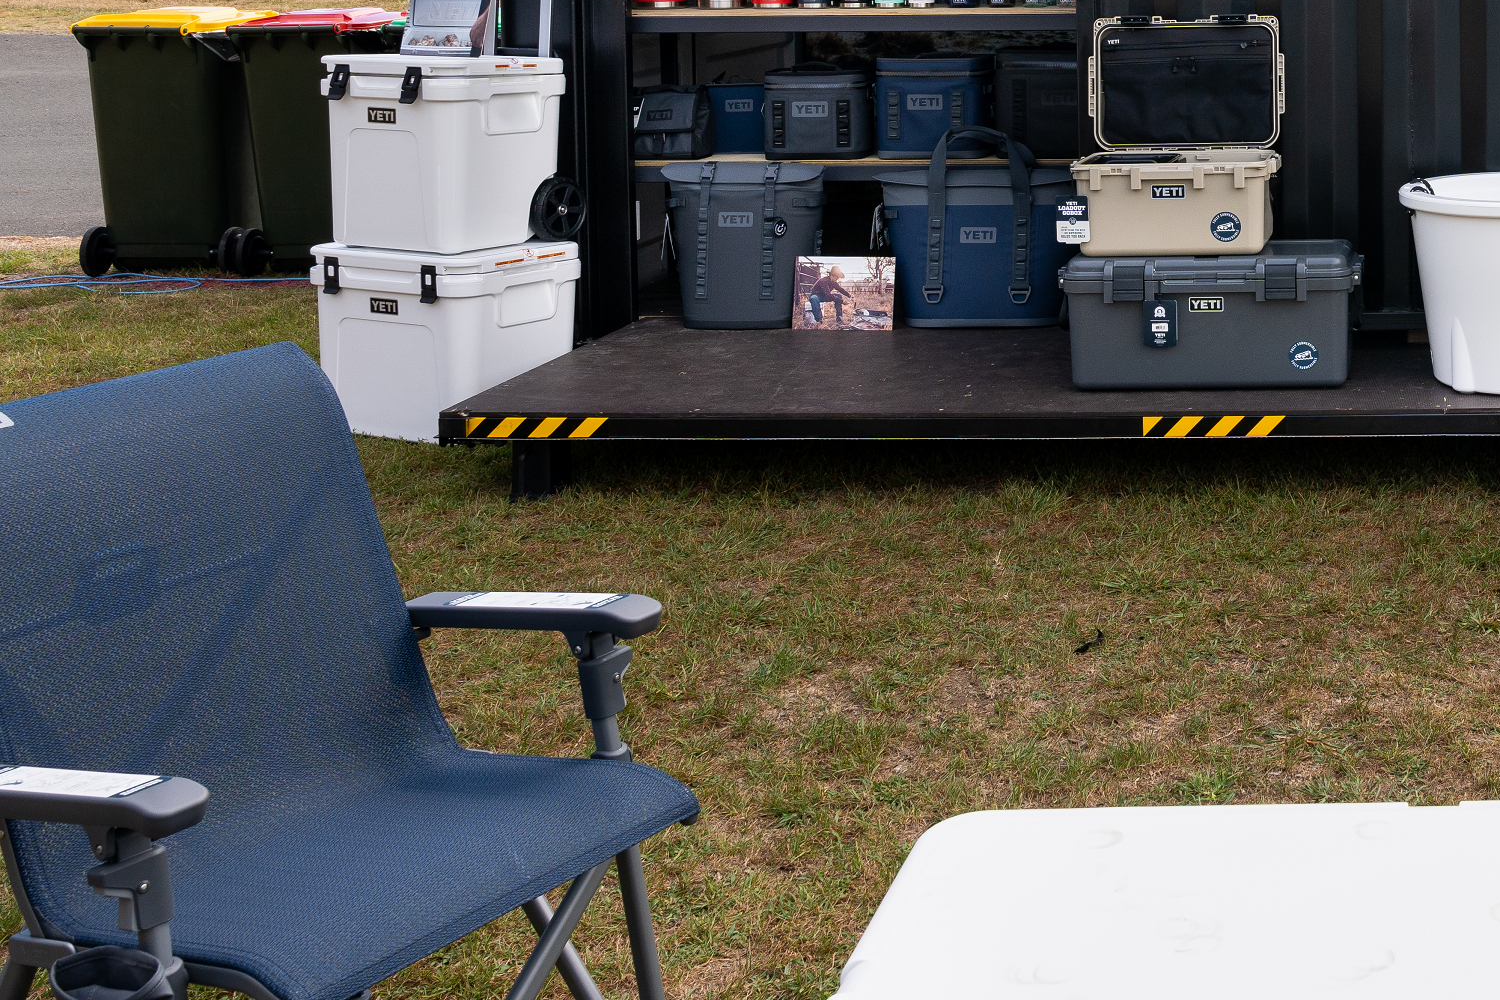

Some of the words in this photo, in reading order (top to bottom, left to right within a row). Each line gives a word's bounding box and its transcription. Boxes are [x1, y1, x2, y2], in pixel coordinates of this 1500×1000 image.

[727, 101, 751, 110] YETI
[910, 98, 940, 107] YETI
[796, 104, 826, 114] YETI
[369, 110, 395, 122] YETI
[650, 111, 671, 119] YETI
[1153, 187, 1183, 197] YETI
[721, 215, 750, 225] YETI
[963, 231, 994, 240] YETI
[371, 300, 397, 313] YETI
[1191, 300, 1221, 309] YETI
